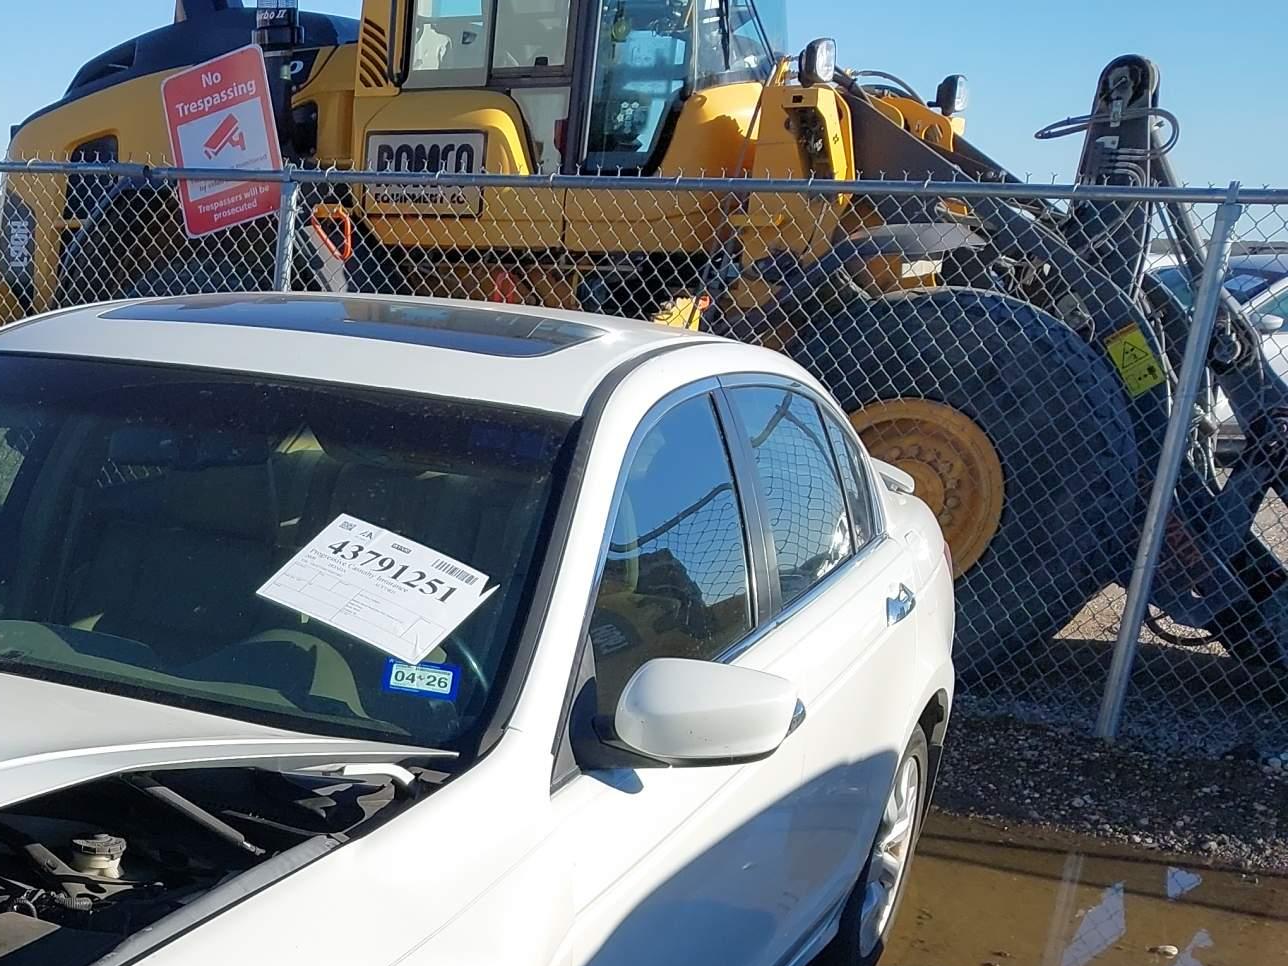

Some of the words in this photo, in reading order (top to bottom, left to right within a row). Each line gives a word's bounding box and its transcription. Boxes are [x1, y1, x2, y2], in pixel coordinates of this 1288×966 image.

[201, 72, 222, 88] No
[176, 80, 256, 117] Trespassing
[198, 193, 243, 214] Trespassers
[243, 187, 258, 201] will
[214, 199, 257, 222] prosecuted
[327, 540, 459, 603] 43791251
